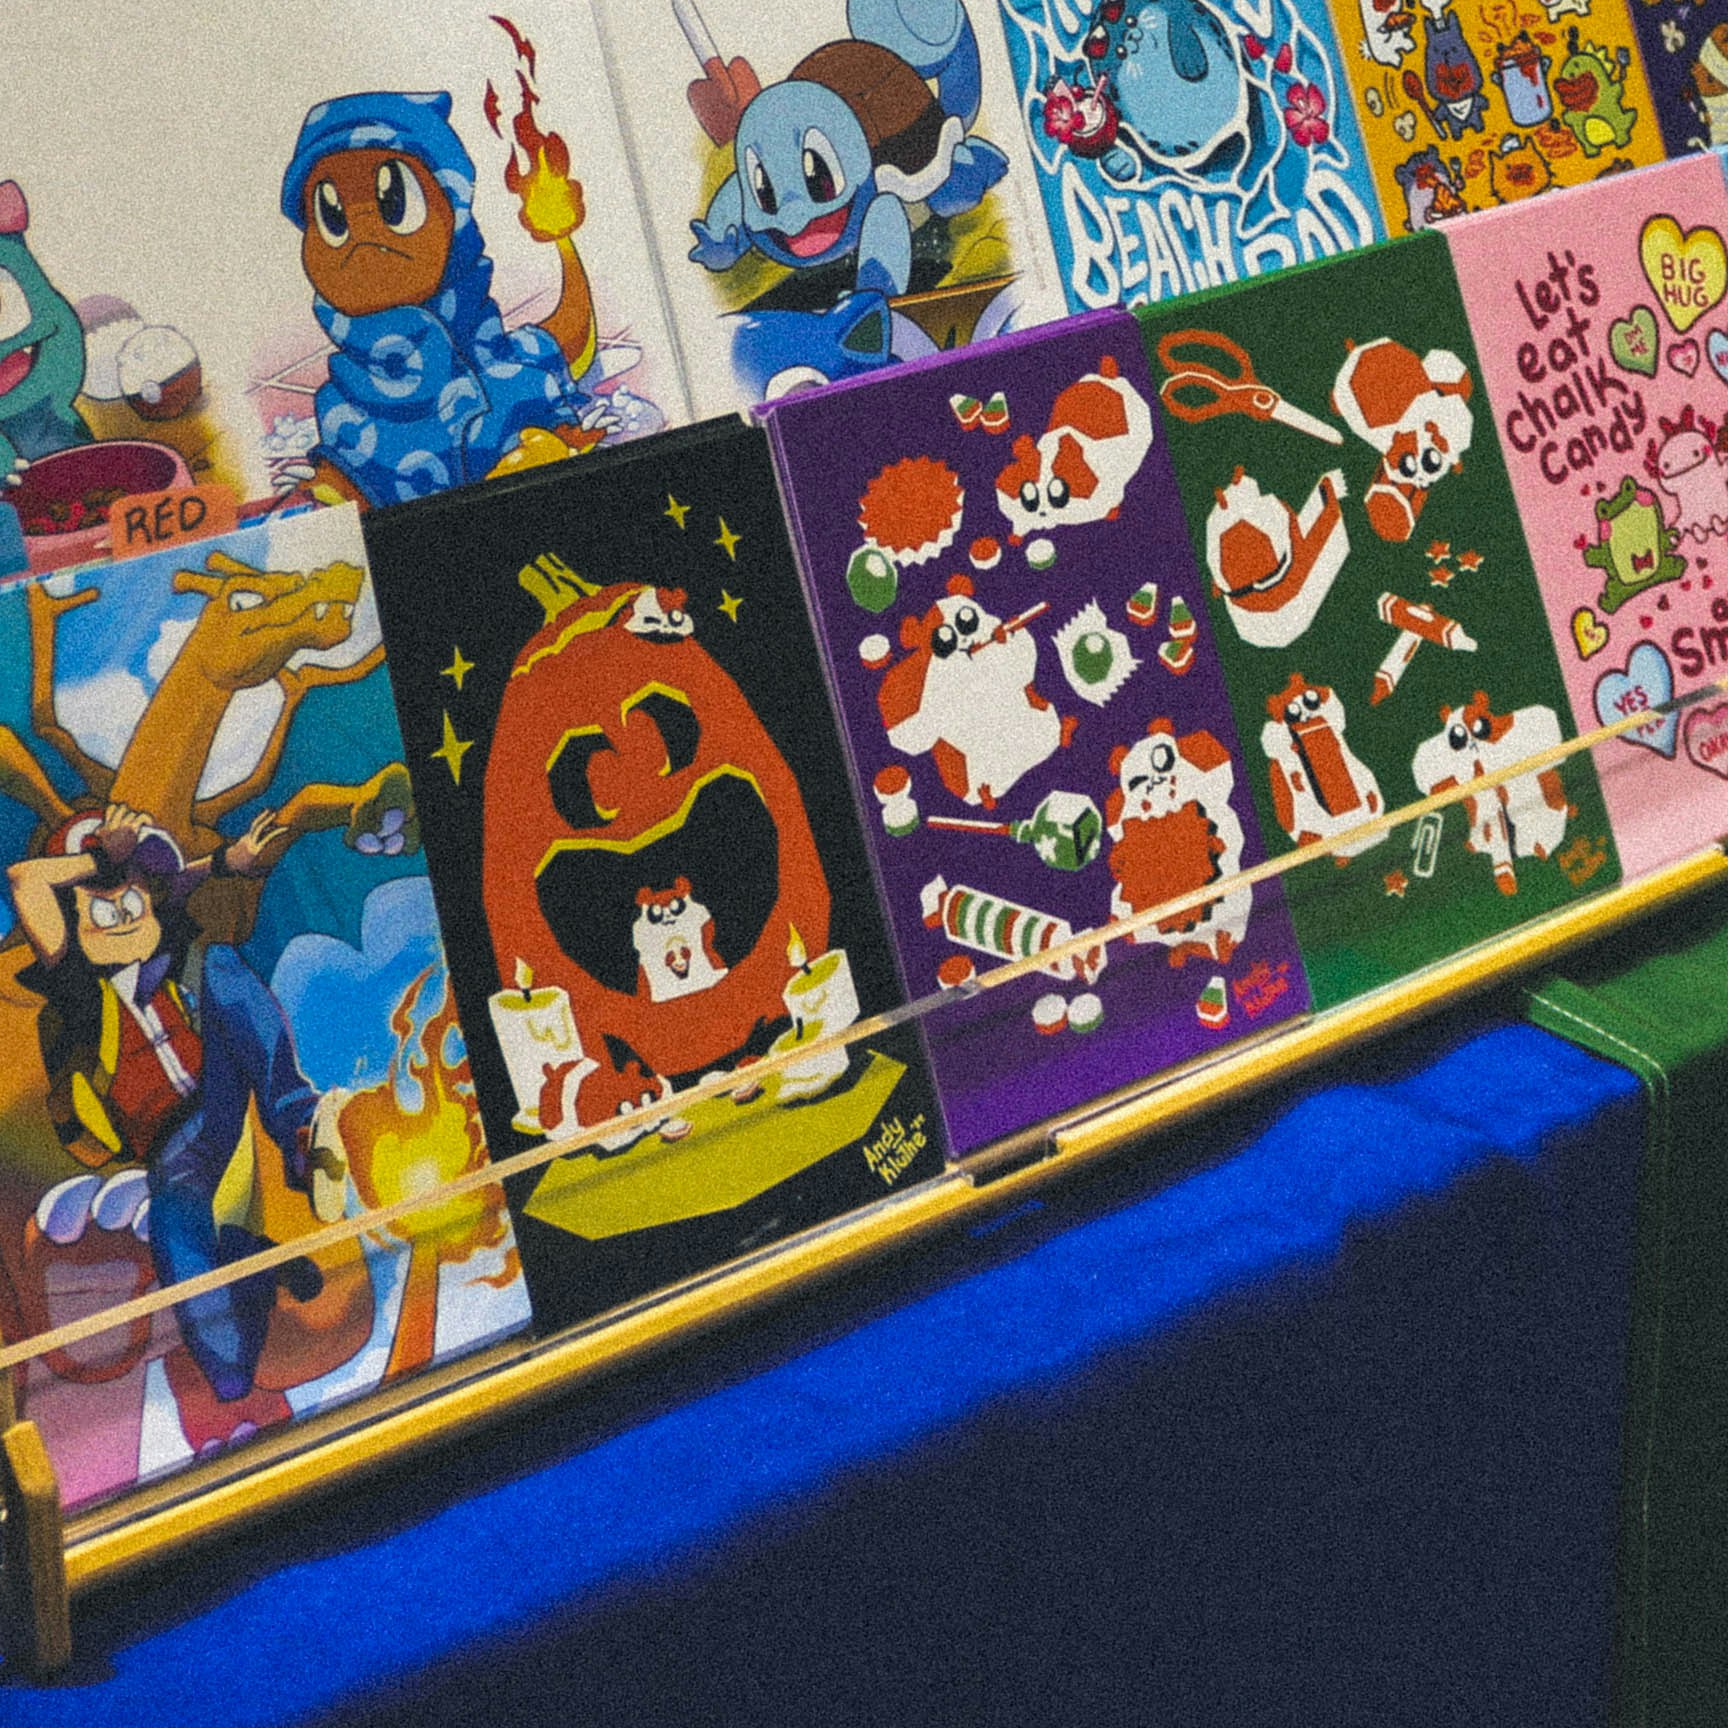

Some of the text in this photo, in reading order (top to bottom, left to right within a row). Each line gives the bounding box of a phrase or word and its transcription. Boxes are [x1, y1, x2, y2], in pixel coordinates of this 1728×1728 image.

[1060, 162, 1237, 310] BEACH
[1660, 252, 1707, 287] BIG
[1661, 283, 1710, 311] HUG
[1516, 306, 1592, 383] eat
[123, 494, 208, 547] RED
[1613, 684, 1649, 717] YES
[862, 1115, 906, 1173] Andy
